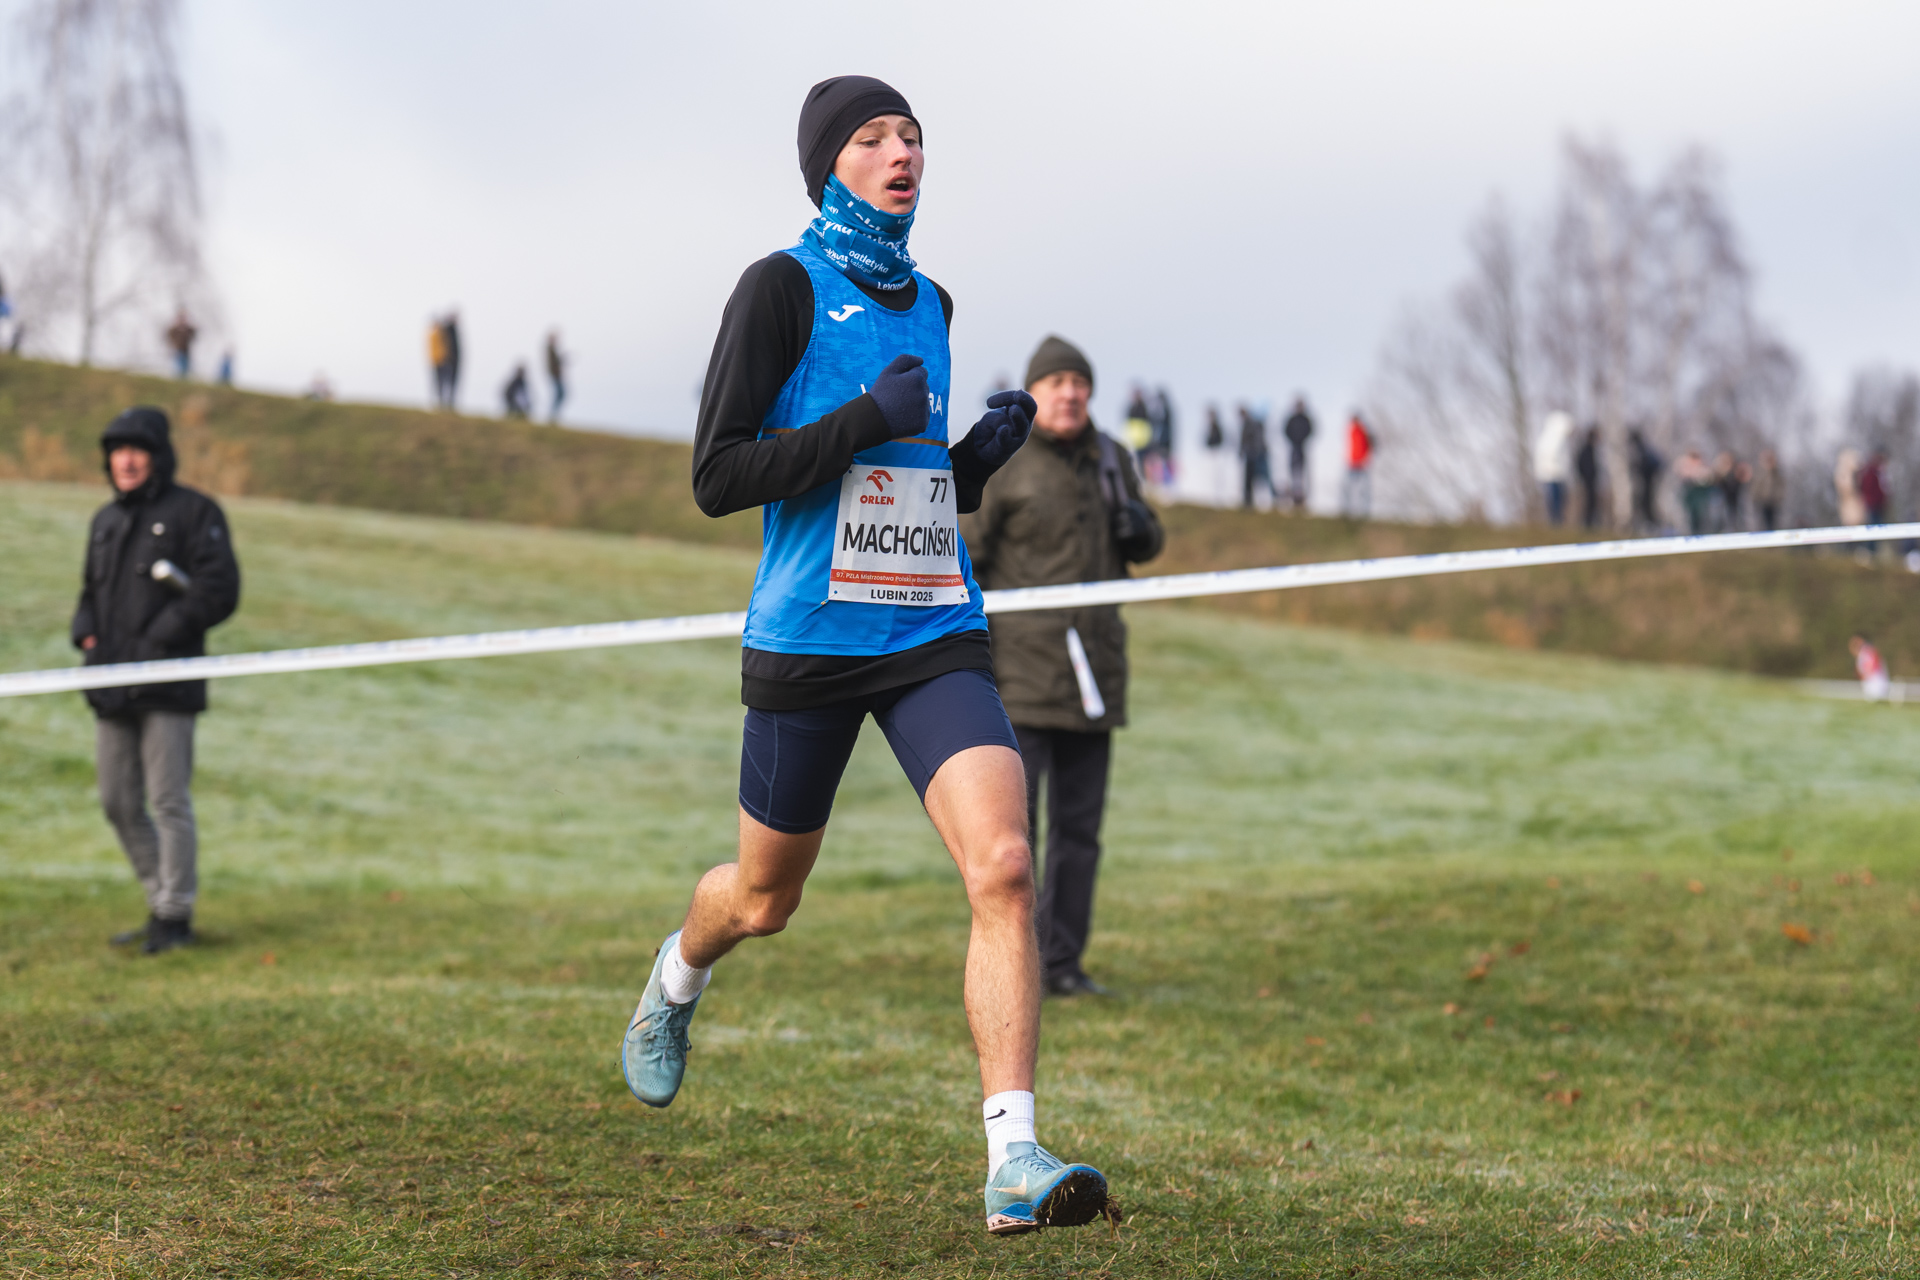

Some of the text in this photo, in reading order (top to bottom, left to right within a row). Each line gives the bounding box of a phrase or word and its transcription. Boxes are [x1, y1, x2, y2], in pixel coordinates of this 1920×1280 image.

[930, 477, 948, 503] 77
[860, 494, 895, 506] ORLEN
[842, 520, 956, 557] MACHCIŃSKI
[861, 574, 894, 582] Mistrzostwa
[895, 575, 911, 583] Polski
[870, 588, 934, 602] LUBIN 2025
